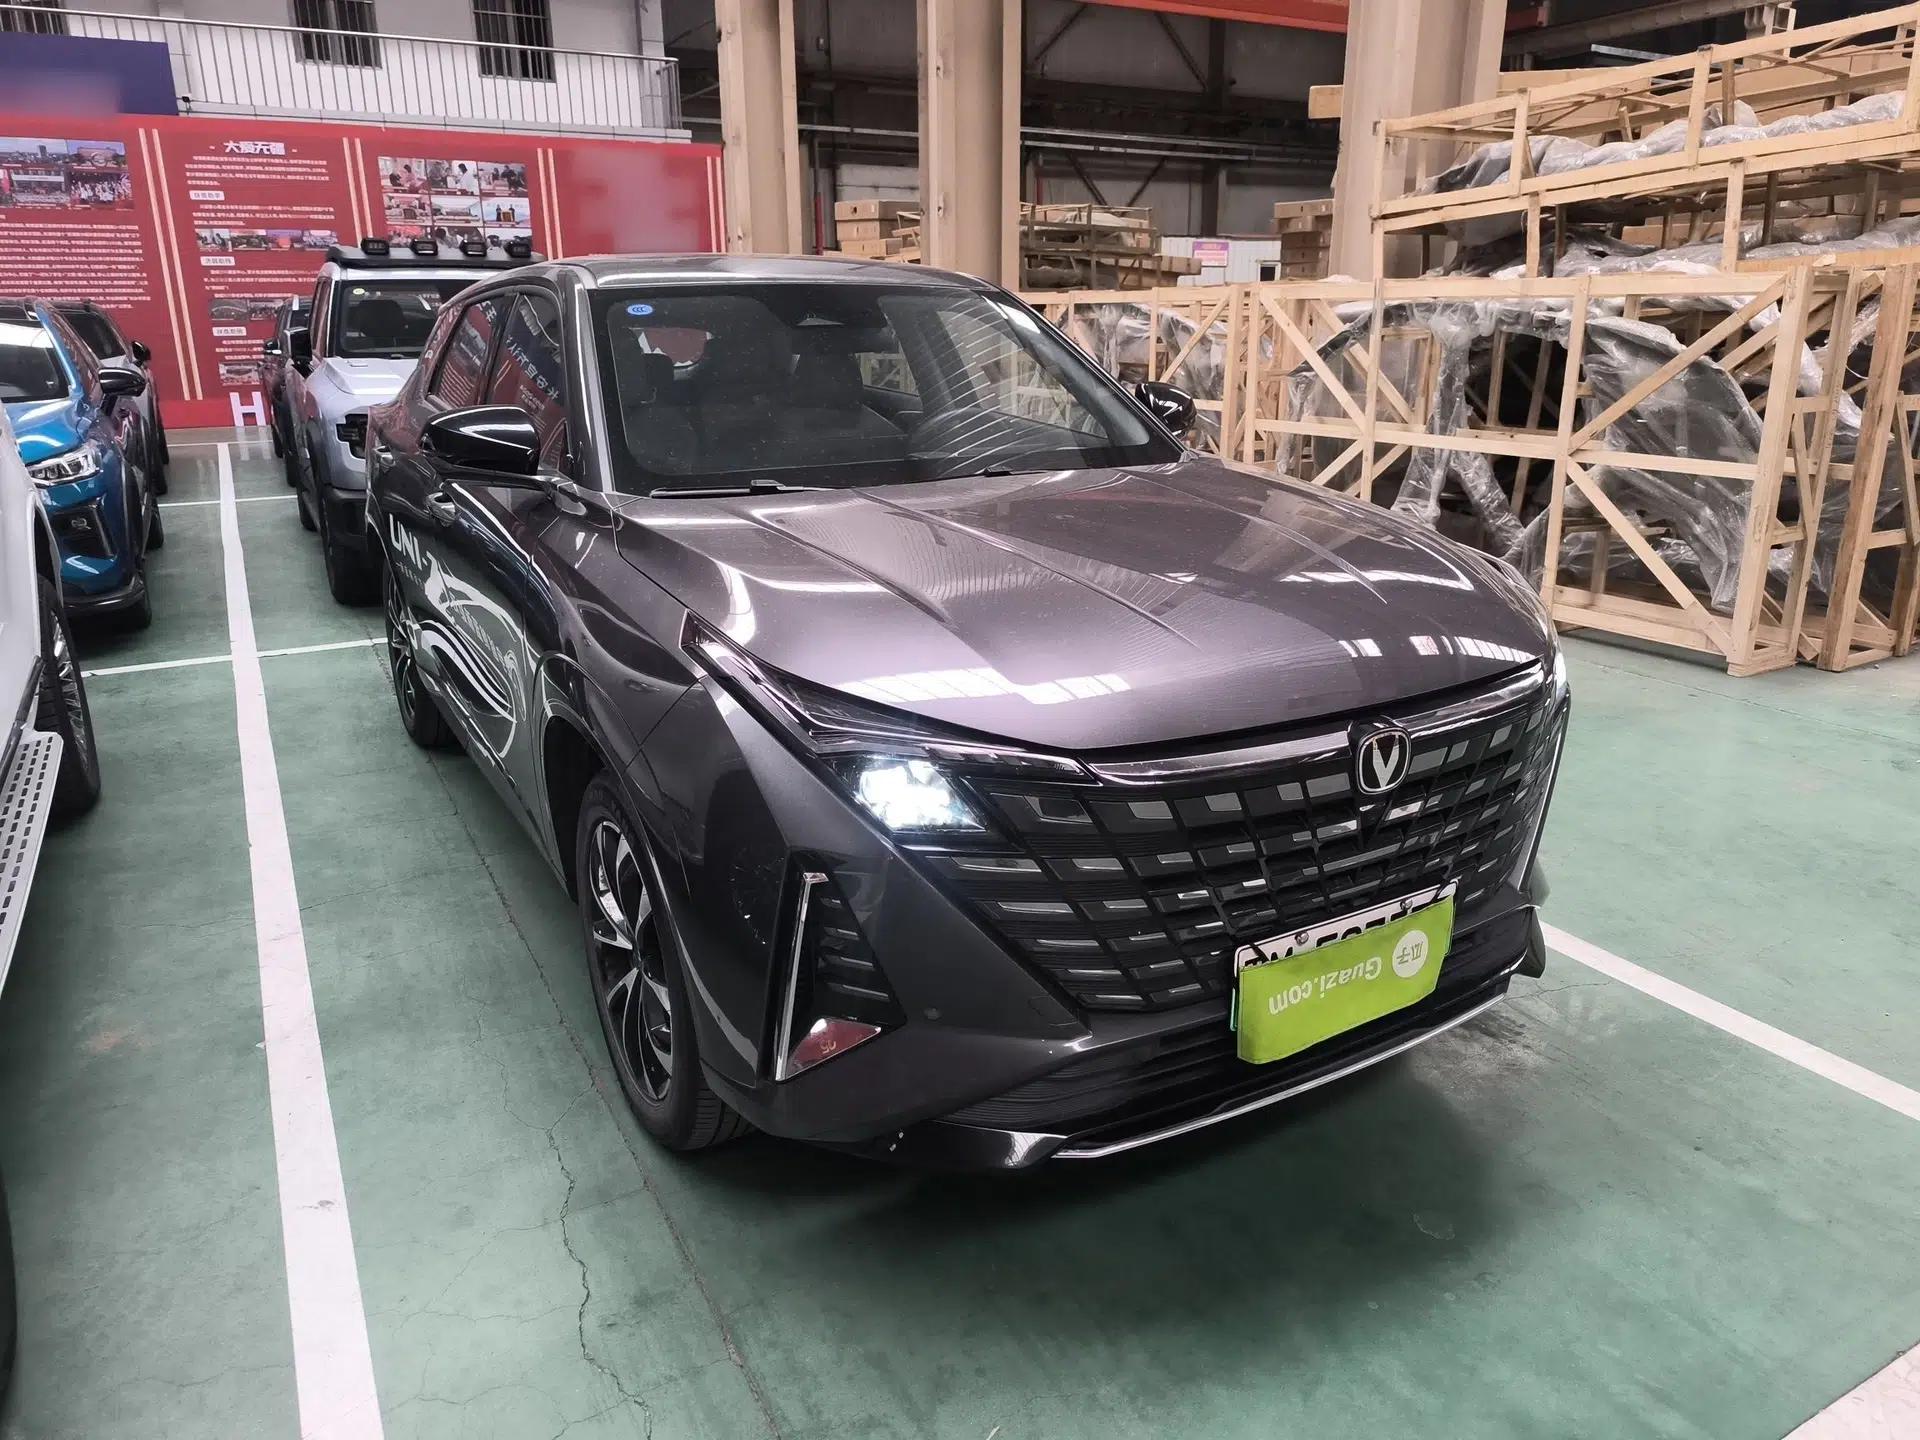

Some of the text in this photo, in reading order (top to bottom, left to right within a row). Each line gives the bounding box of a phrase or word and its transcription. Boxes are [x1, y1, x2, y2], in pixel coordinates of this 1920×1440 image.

[229, 391, 267, 427] H
[1396, 941, 1424, 965] 瓜子
[1268, 956, 1382, 1015] Guazi.com
